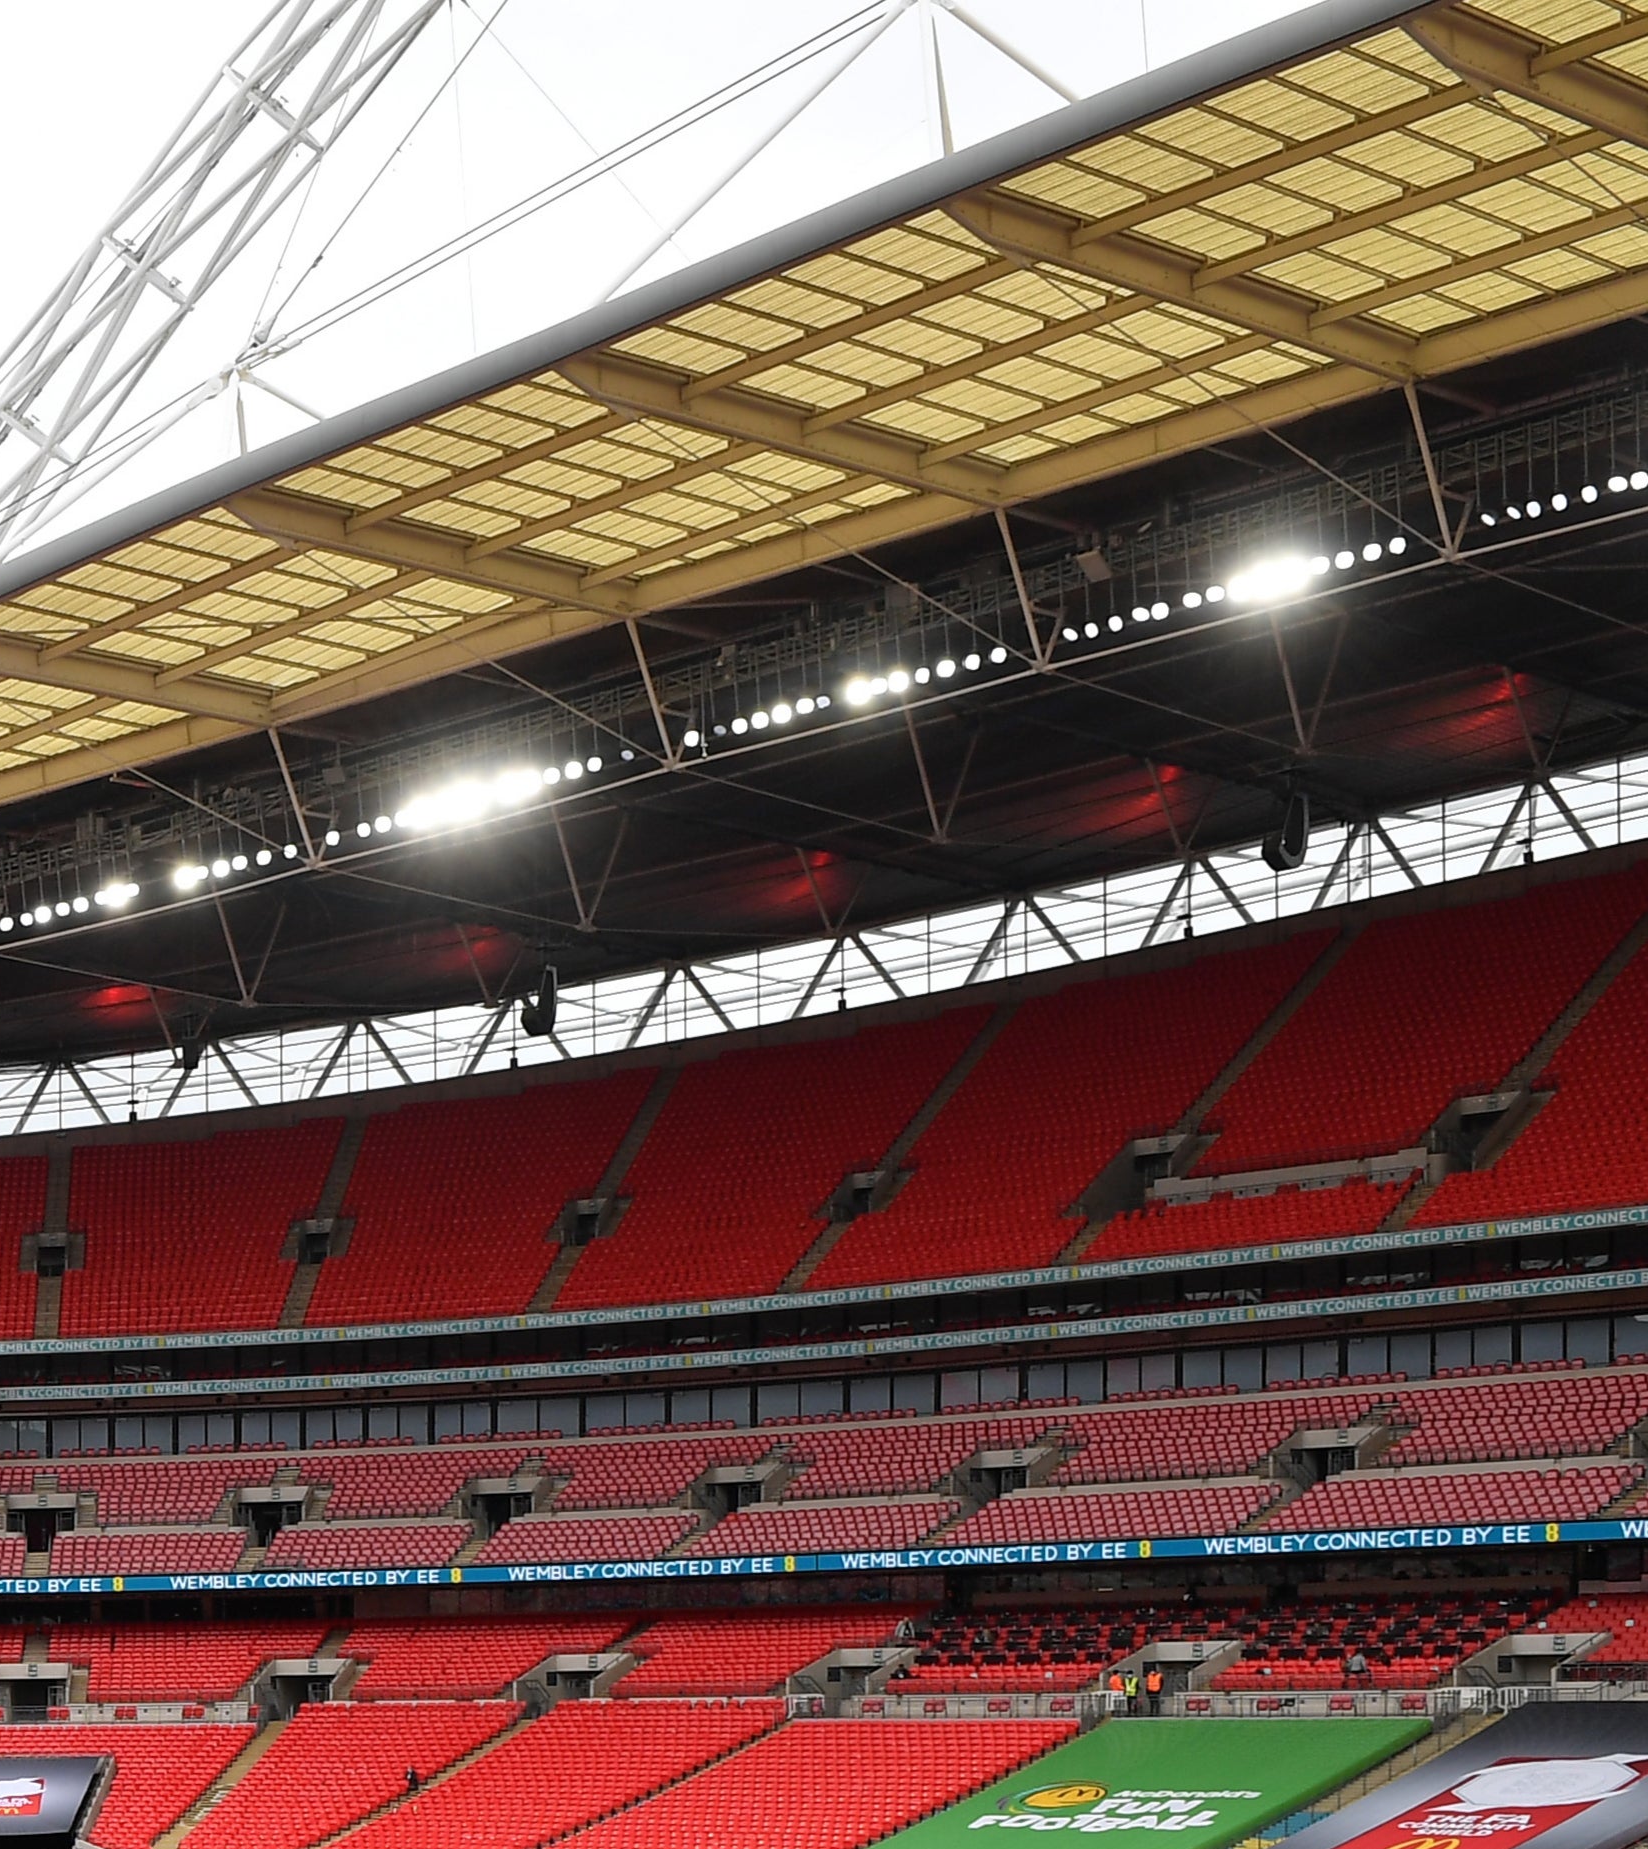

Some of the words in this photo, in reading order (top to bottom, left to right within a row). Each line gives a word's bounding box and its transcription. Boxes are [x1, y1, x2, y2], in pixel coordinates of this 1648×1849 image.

[1495, 1216, 1569, 1236] WEMBLEY
[1573, 1208, 1648, 1228] CONNECT
[1279, 1239, 1349, 1258] WEMBLEY
[1353, 1229, 1439, 1250] CONNECTED
[1079, 1260, 1143, 1278] WEMBLEY
[1147, 1252, 1228, 1271] CONNECTED
[1466, 1281, 1539, 1300] WEMBLEY
[1543, 1272, 1637, 1293] CONNECTED
[1255, 1301, 1323, 1319] WEMBLEY
[1326, 1293, 1411, 1312] CONNECTED
[1057, 1319, 1121, 1336] WEMBLEY
[1124, 1312, 1204, 1330] CONNECTED
[1202, 1534, 1308, 1555] WEMBLEY
[1314, 1528, 1451, 1551] CONNECTED
[1462, 1526, 1491, 1545] BY
[1503, 1525, 1531, 1543] EE
[841, 1550, 933, 1570] WEMBLEY
[938, 1545, 1057, 1566] CONNECTED
[1067, 1543, 1092, 1561] BY
[1102, 1542, 1125, 1559] EE
[169, 1574, 259, 1590] WEMBLEY
[264, 1571, 377, 1588] CONNECTED
[386, 1570, 409, 1585] BY
[417, 1569, 439, 1584] EE
[507, 1563, 597, 1581] WEMBLEY
[600, 1559, 713, 1578] CONNECTED
[721, 1558, 743, 1574] BY
[751, 1557, 773, 1573] EE
[48, 1578, 71, 1593] BY
[79, 1578, 101, 1592] EE
[1111, 1789, 1263, 1799] McDonald's
[967, 1810, 1219, 1832] FOOTBALL
[1397, 1821, 1536, 1831] COMMUNITY
[1425, 1814, 1484, 1824] THE
[1481, 1813, 1531, 1825] FA
